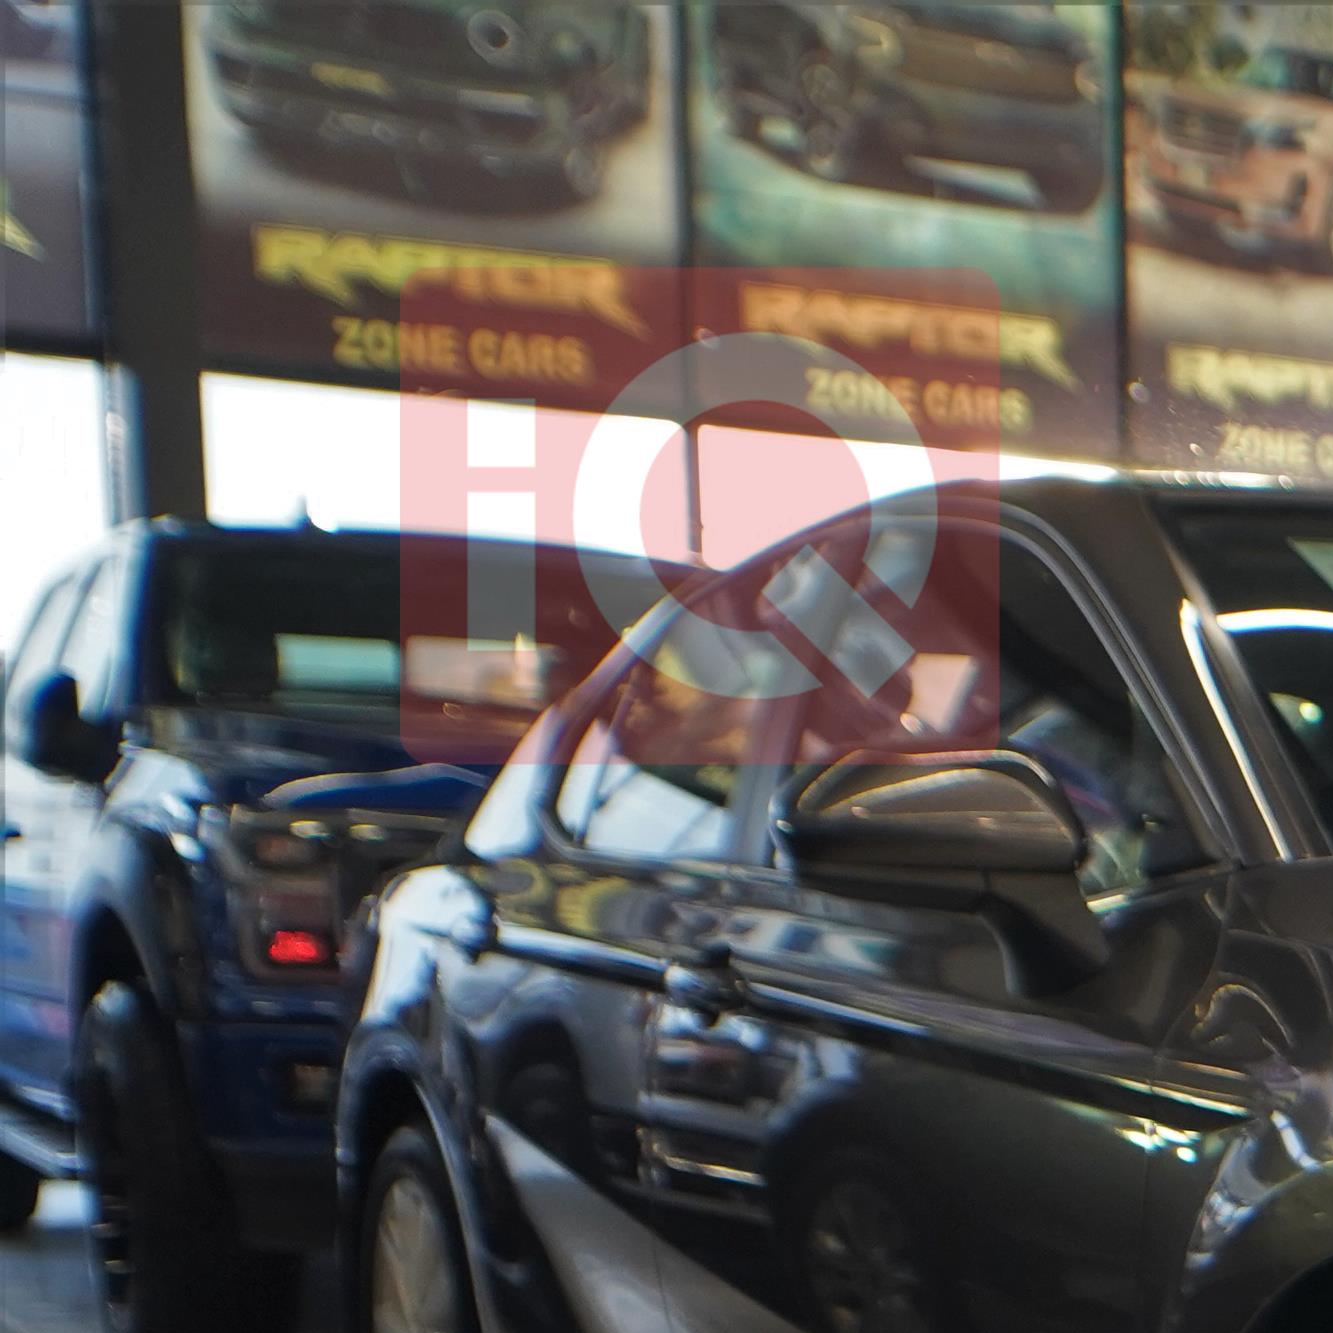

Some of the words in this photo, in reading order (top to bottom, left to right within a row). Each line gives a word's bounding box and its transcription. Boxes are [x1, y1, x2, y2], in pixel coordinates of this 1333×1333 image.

[331, 316, 463, 372] ZONE
[468, 327, 591, 384] CARS
[805, 366, 919, 420] ZONE
[922, 377, 1032, 432] CARS
[1219, 422, 1309, 470] ZONE
